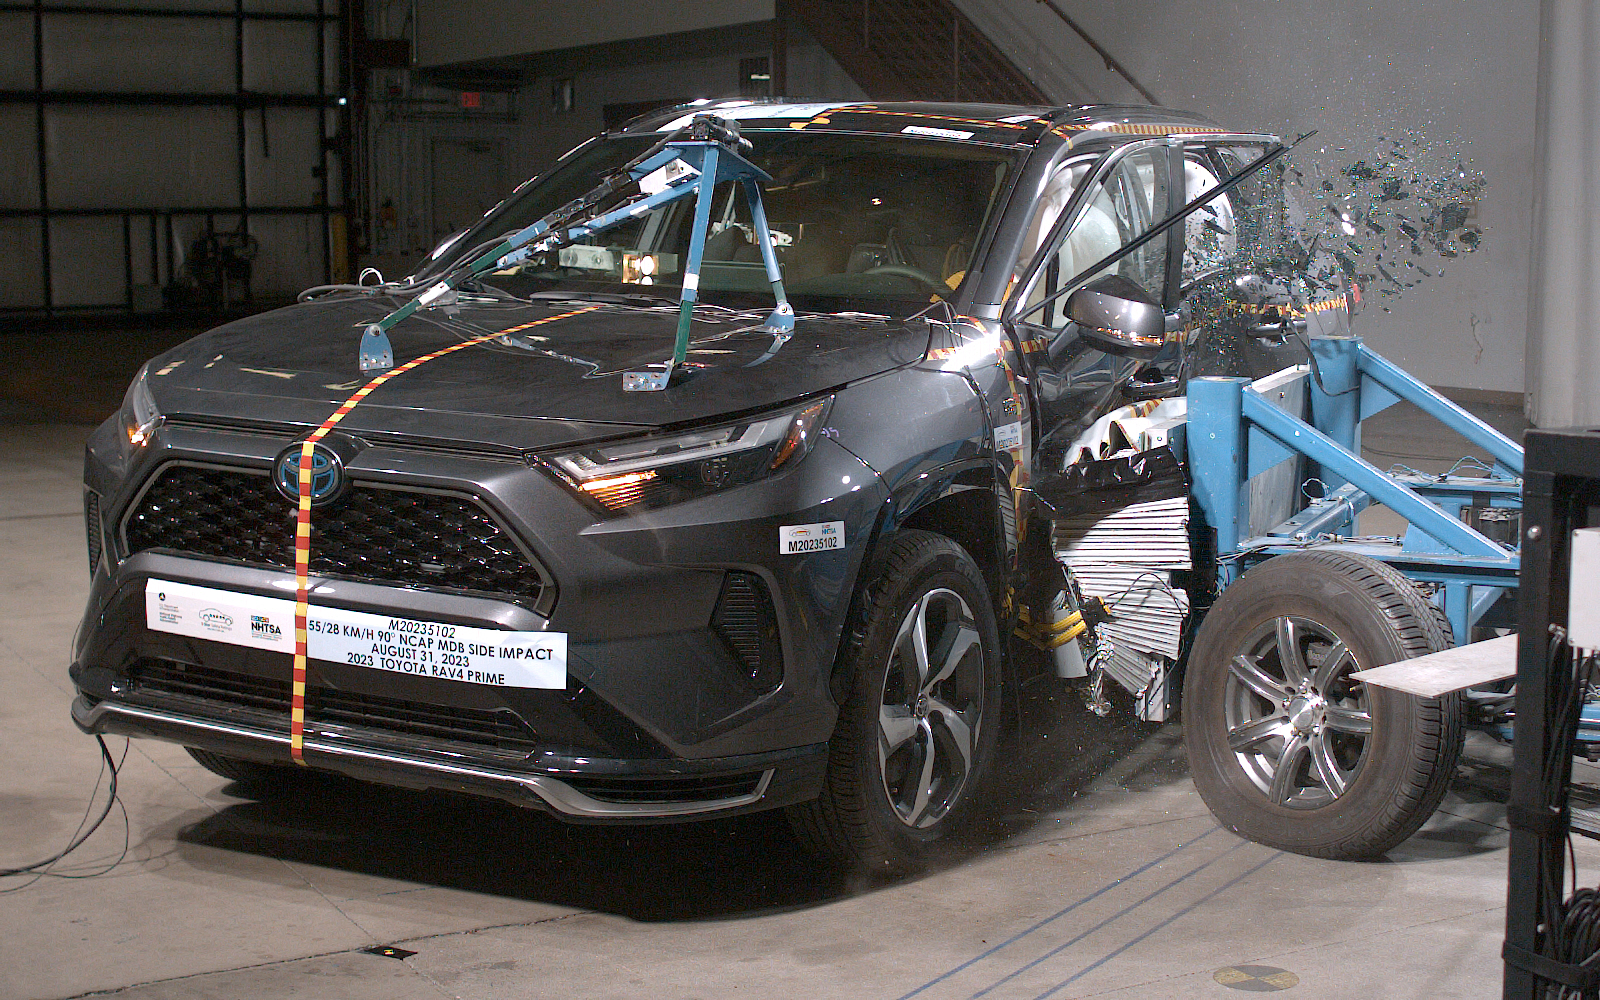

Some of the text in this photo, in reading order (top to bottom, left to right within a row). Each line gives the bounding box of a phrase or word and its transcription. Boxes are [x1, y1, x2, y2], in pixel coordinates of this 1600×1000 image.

[788, 537, 837, 552] M20235102
[251, 622, 282, 635] NHTSA
[388, 619, 456, 639] M20235102
[308, 620, 340, 635] 55/28
[343, 625, 374, 641] KM/H
[399, 634, 434, 649] NCAP
[438, 639, 465, 654] MDB
[468, 643, 495, 658] SIDE
[499, 647, 554, 661] IMPACT
[371, 643, 470, 668] AUGUST 31, 2023
[347, 652, 505, 685] 2023 TOYOTA RAV4 PRIME
